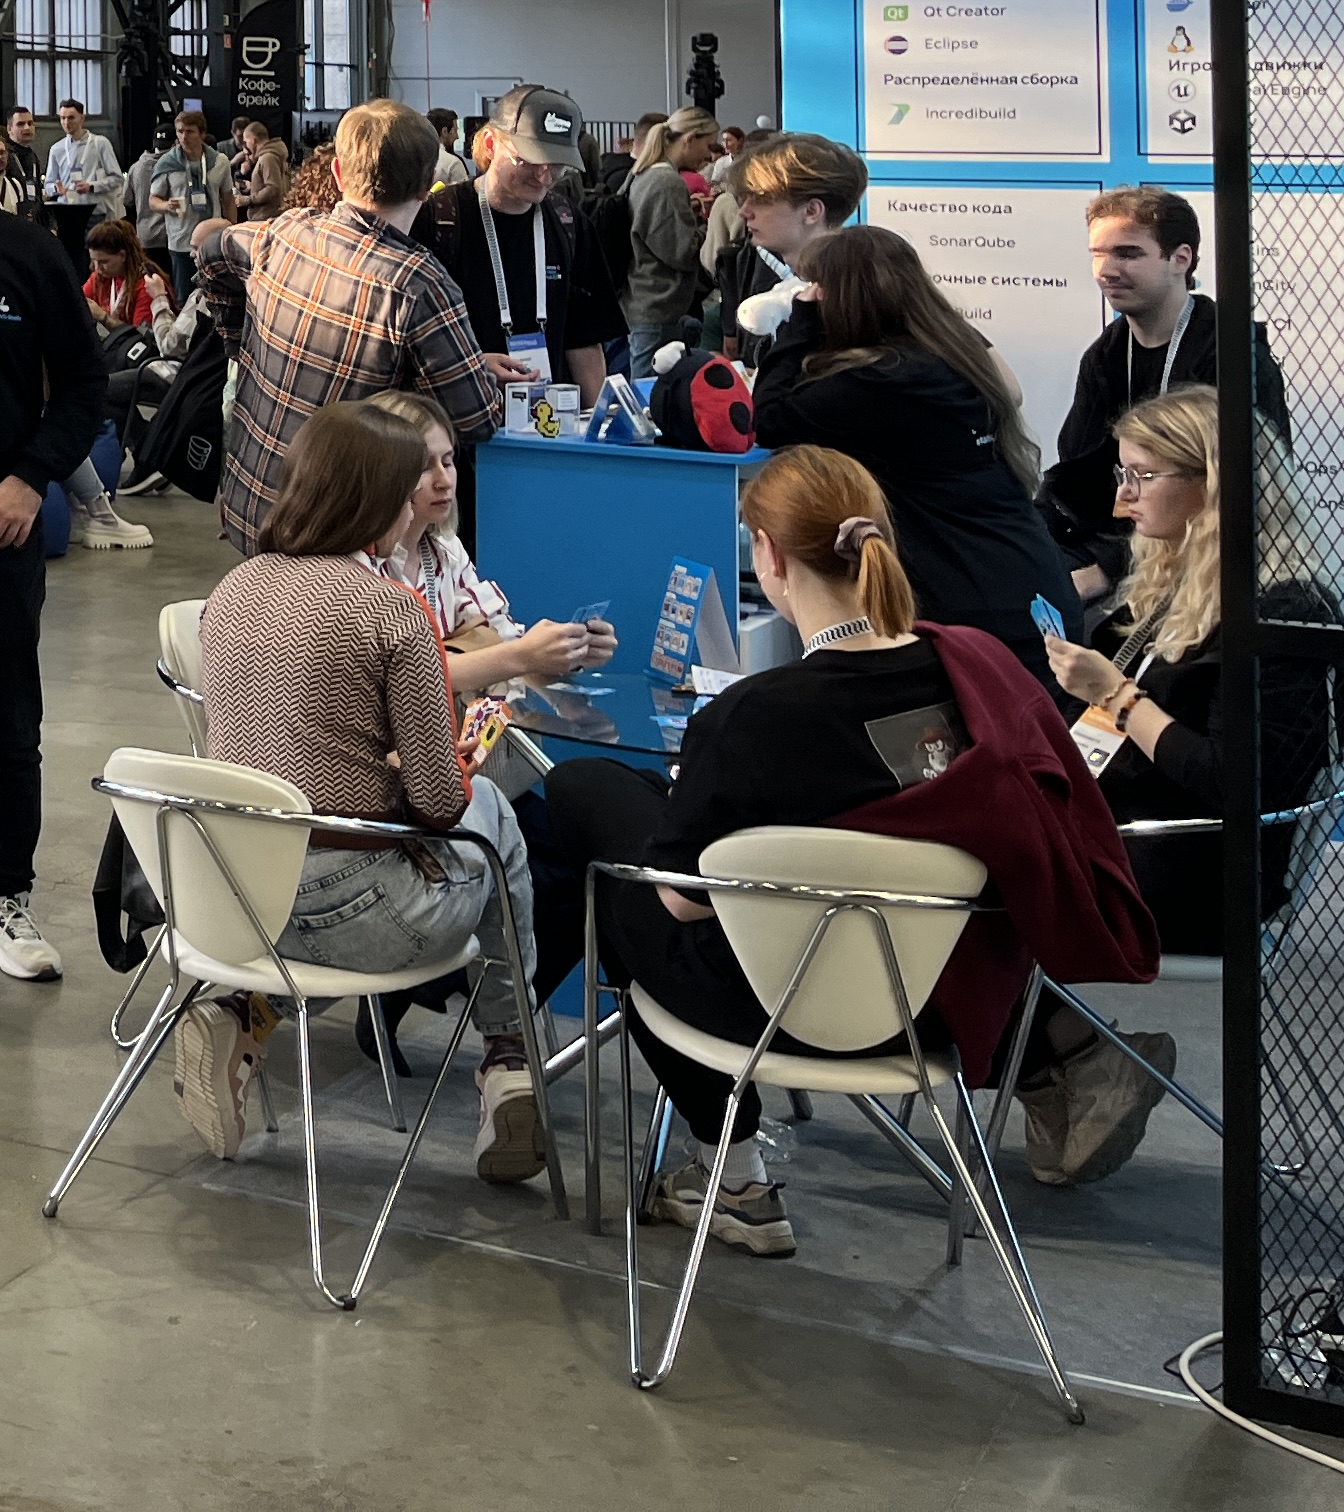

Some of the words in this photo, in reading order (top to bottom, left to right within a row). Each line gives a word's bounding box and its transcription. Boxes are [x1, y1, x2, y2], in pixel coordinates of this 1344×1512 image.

[887, 7, 904, 20] Qt
[923, 6, 943, 18] Qt
[946, 5, 1008, 18] Creator
[924, 37, 979, 53] Eclipse
[238, 77, 281, 94] Кофе-
[883, 71, 1018, 88] Распределённая
[1021, 73, 1078, 88] сборка
[237, 92, 280, 108] брейк
[925, 106, 1017, 120] Incredibuild
[887, 200, 968, 214] Качество
[972, 203, 1013, 215] кода
[929, 235, 1016, 249] SonarQube
[991, 275, 1068, 288] системы
